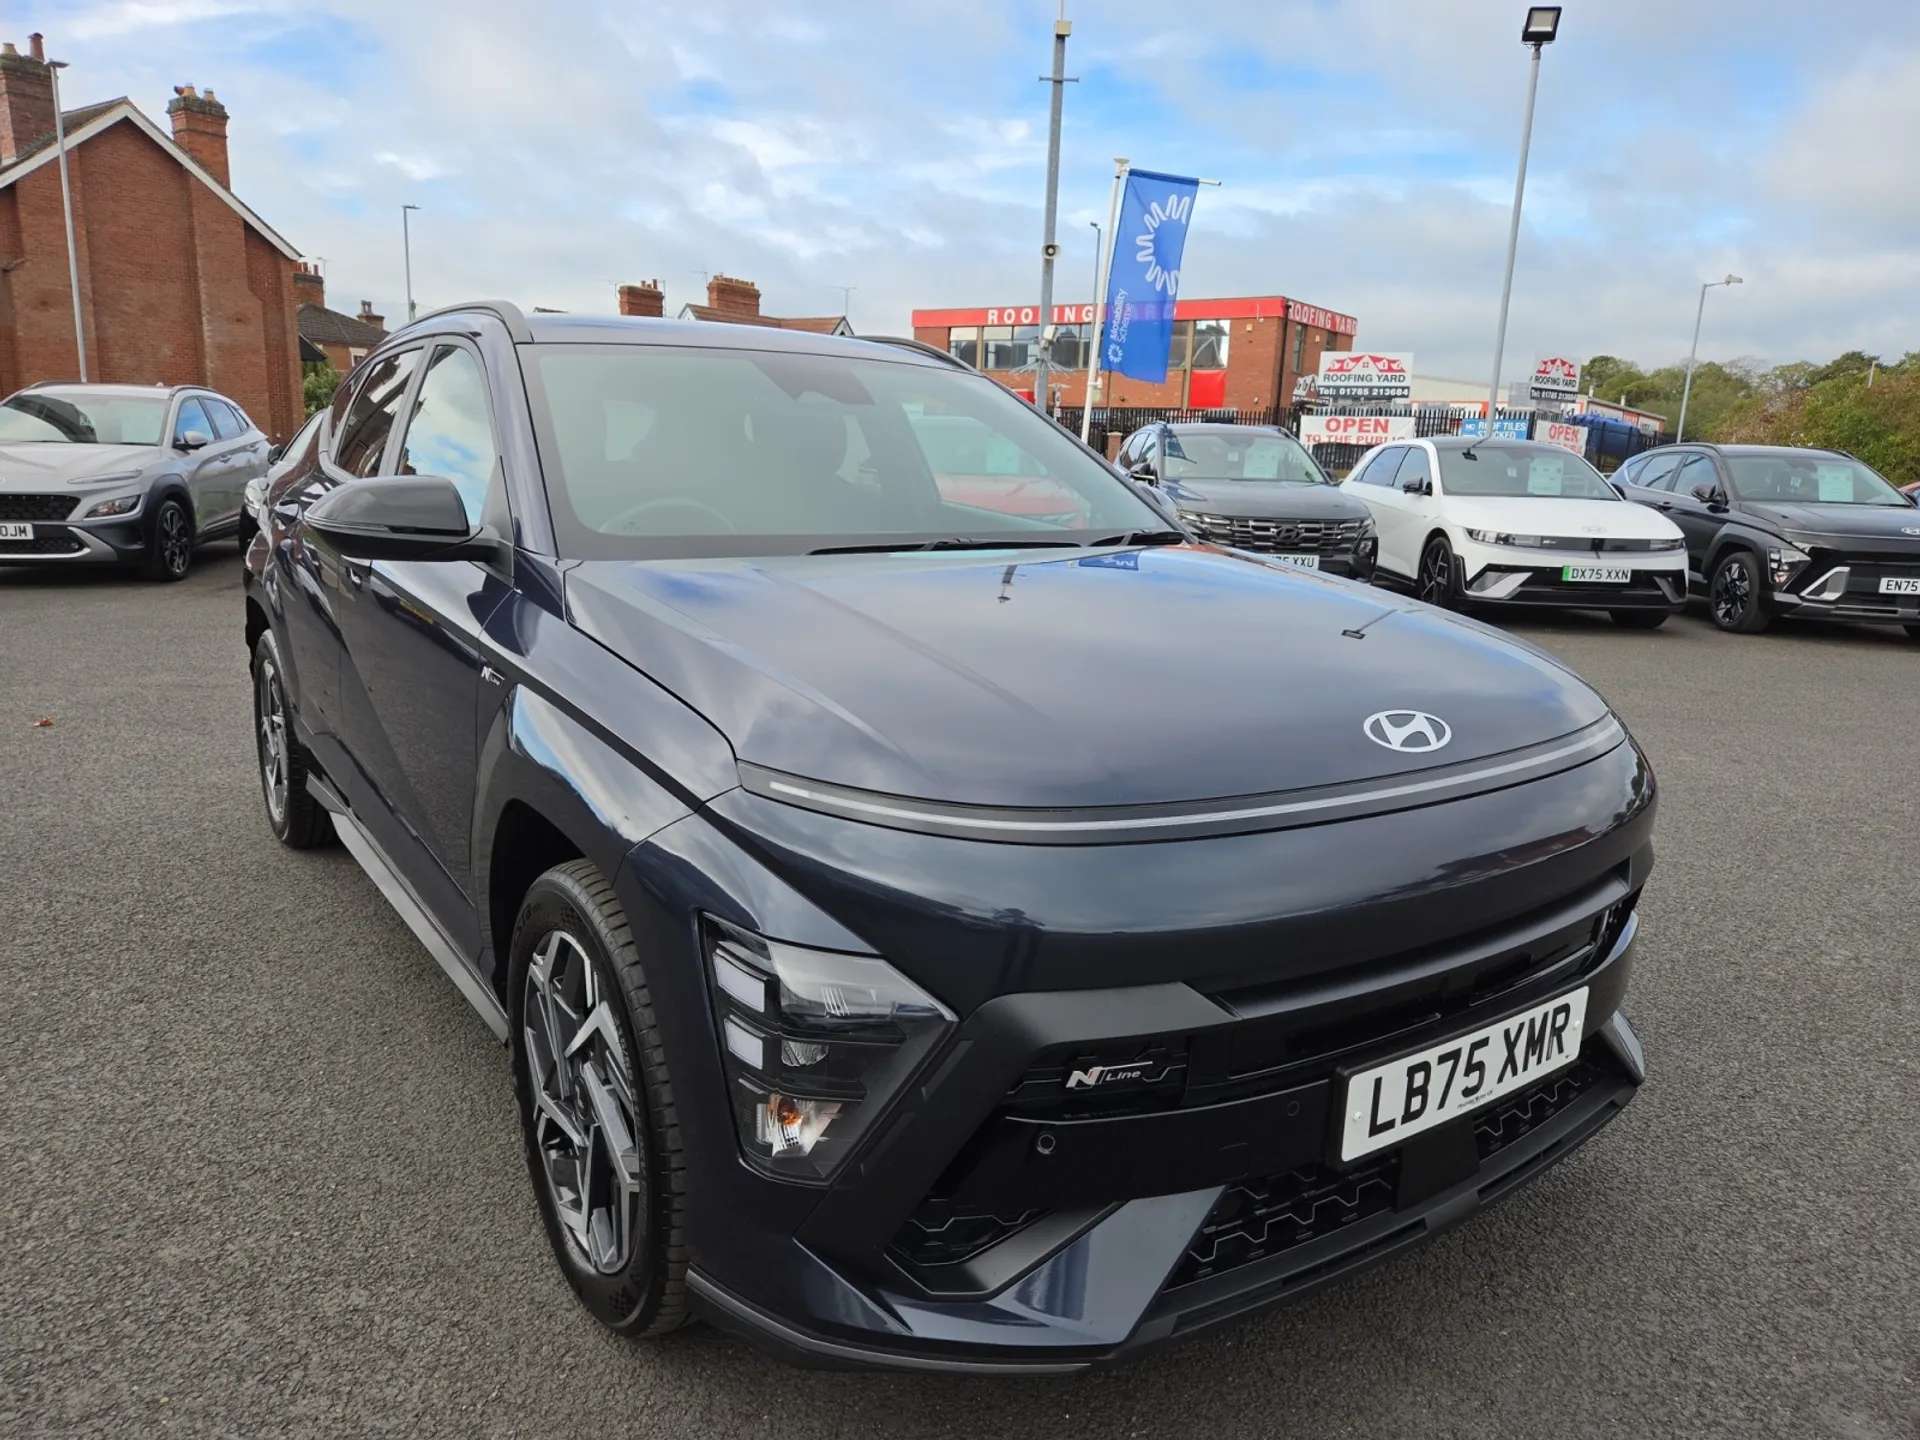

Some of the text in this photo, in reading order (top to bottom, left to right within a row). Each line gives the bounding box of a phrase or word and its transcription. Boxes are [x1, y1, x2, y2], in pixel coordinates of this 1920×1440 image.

[988, 306, 1094, 325] ROOING
[1288, 302, 1332, 330] ROOFING
[1323, 374, 1406, 383] ROOFING YARD
[1325, 417, 1390, 433] OPEN
[1503, 421, 1527, 431] TILES
[1305, 434, 1321, 443] TO
[1327, 434, 1352, 443] THE
[1478, 430, 1516, 441] STCKED
[1549, 423, 1579, 442] OPEN
[1571, 567, 1629, 580] DX75 XXN
[1886, 579, 1919, 592] EN75
[1105, 1070, 1142, 1081] Line
[1368, 1002, 1571, 1138] LB75 XMR
